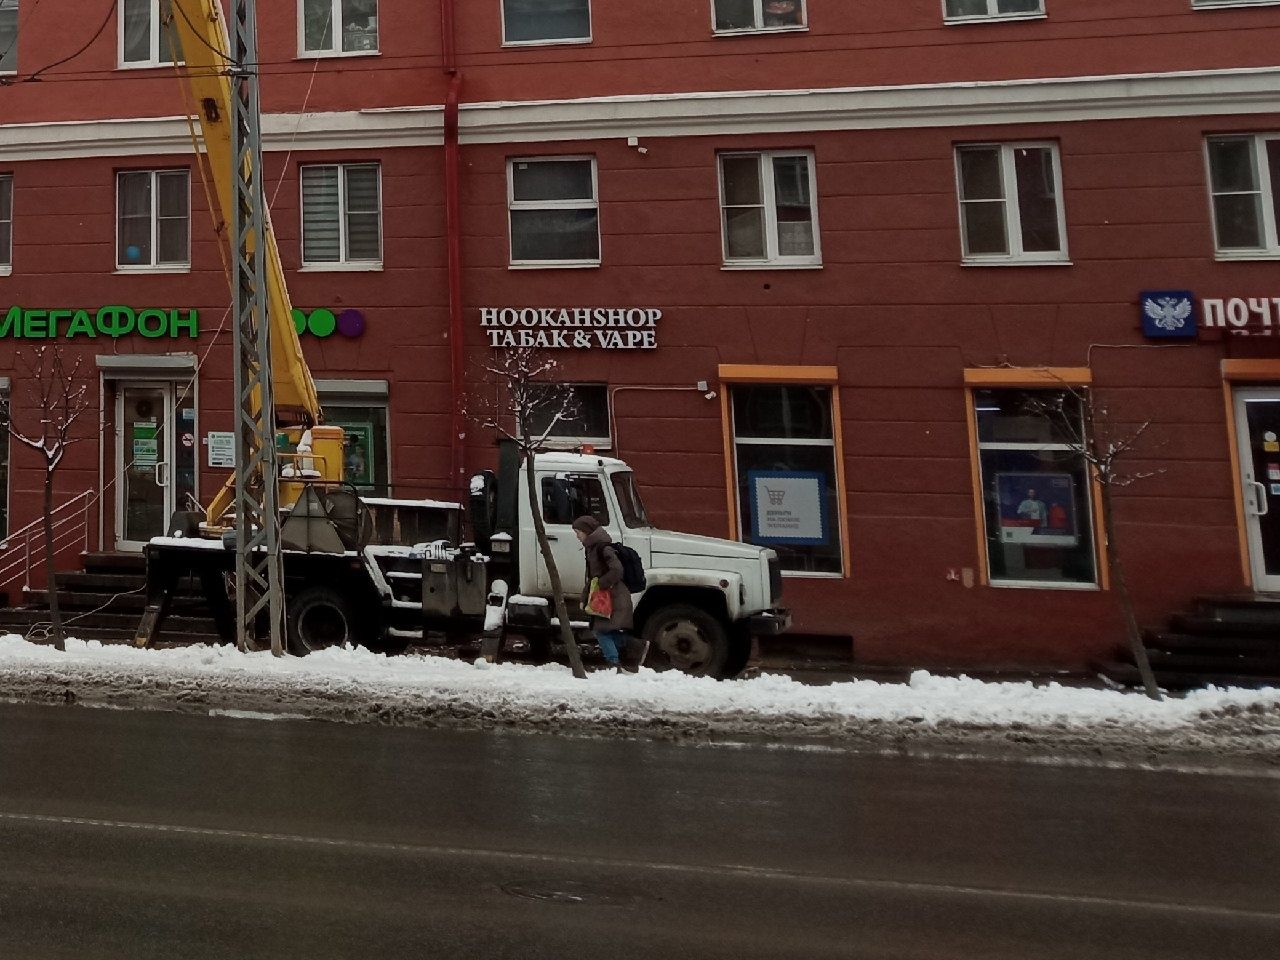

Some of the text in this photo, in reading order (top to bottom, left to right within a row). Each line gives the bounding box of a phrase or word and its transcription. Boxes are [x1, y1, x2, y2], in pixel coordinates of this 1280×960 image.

[478, 307, 663, 327] HOOKAHSHOP
[486, 329, 658, 349] ТАБАК & VAPE
